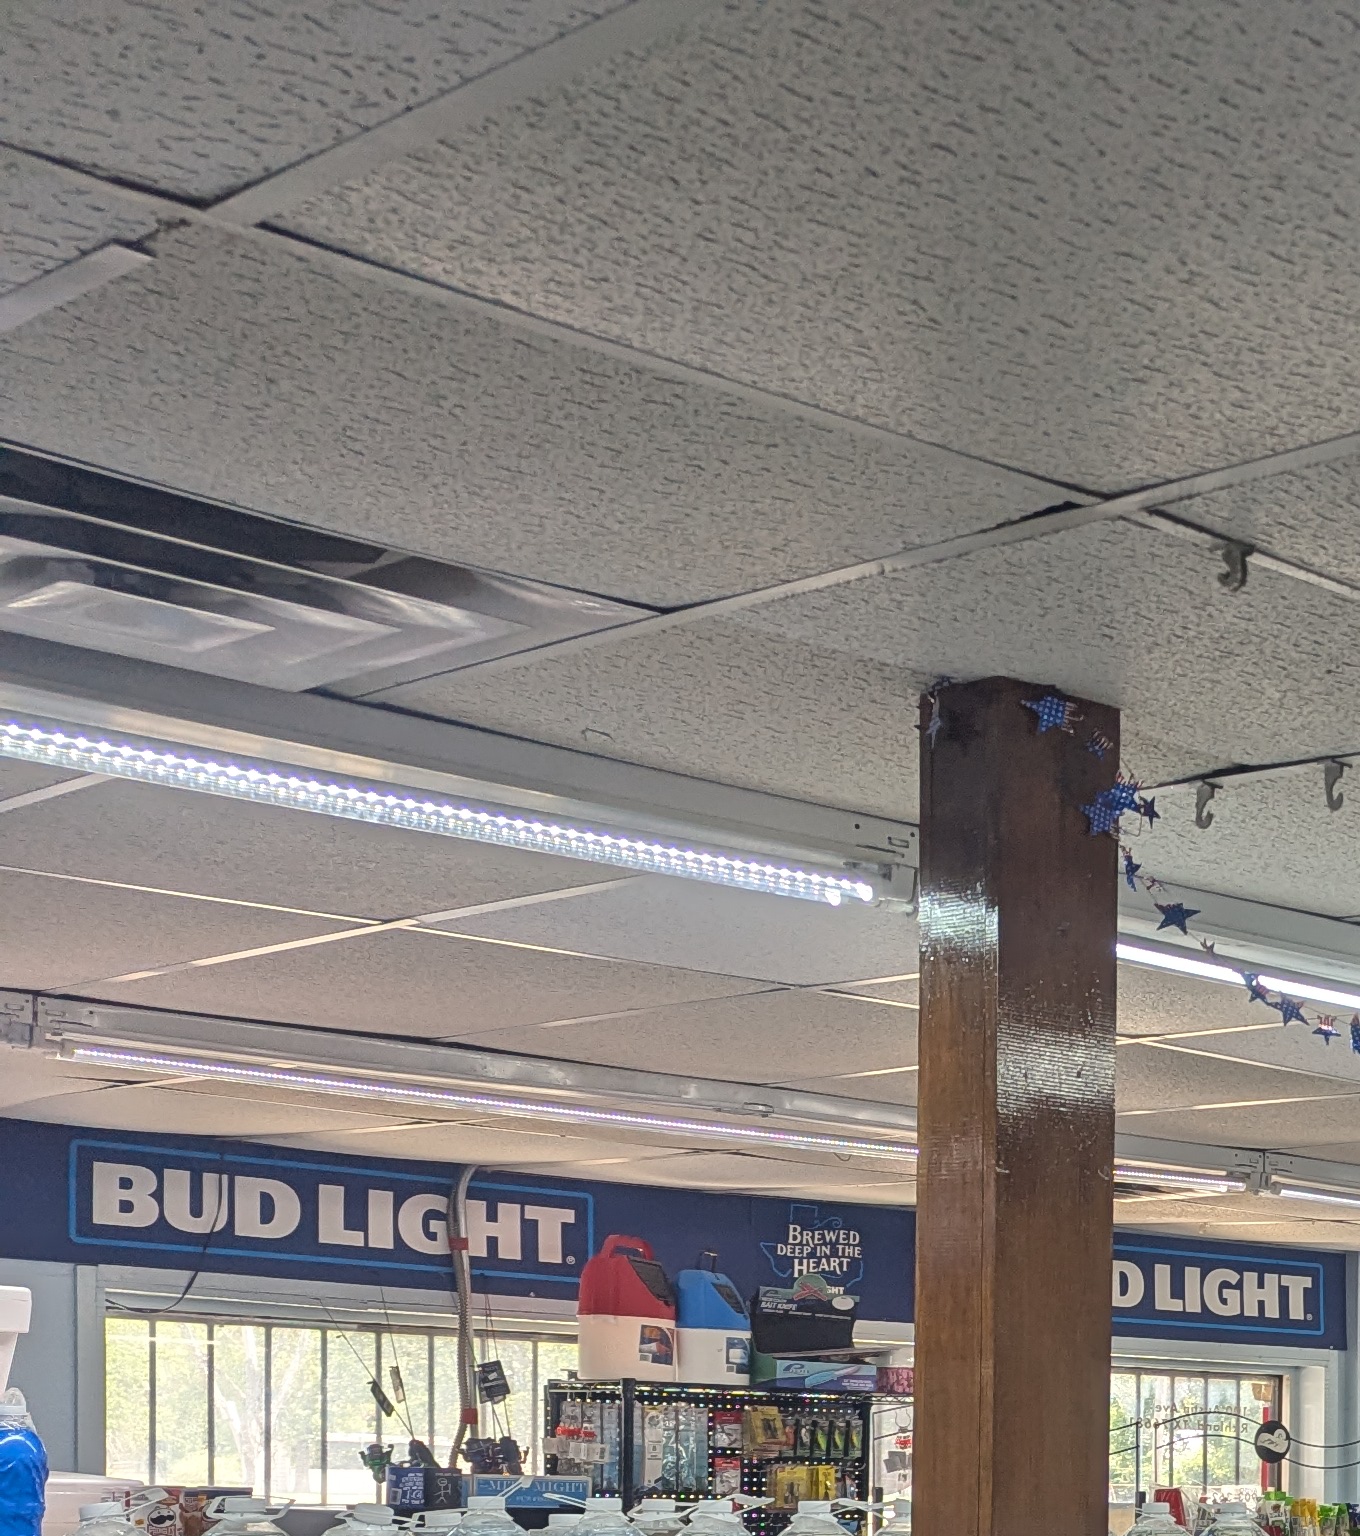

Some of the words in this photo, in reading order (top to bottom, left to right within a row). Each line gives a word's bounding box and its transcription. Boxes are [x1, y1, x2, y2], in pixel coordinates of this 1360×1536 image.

[91, 1160, 302, 1240] BUD
[316, 1184, 576, 1265] LIGHT
[788, 1224, 860, 1247] BREWED
[777, 1244, 812, 1257] DEEP
[816, 1246, 830, 1256] IN
[836, 1244, 862, 1258] THE
[793, 1258, 851, 1278] HEART
[1154, 1264, 1313, 1321] LIGHT
